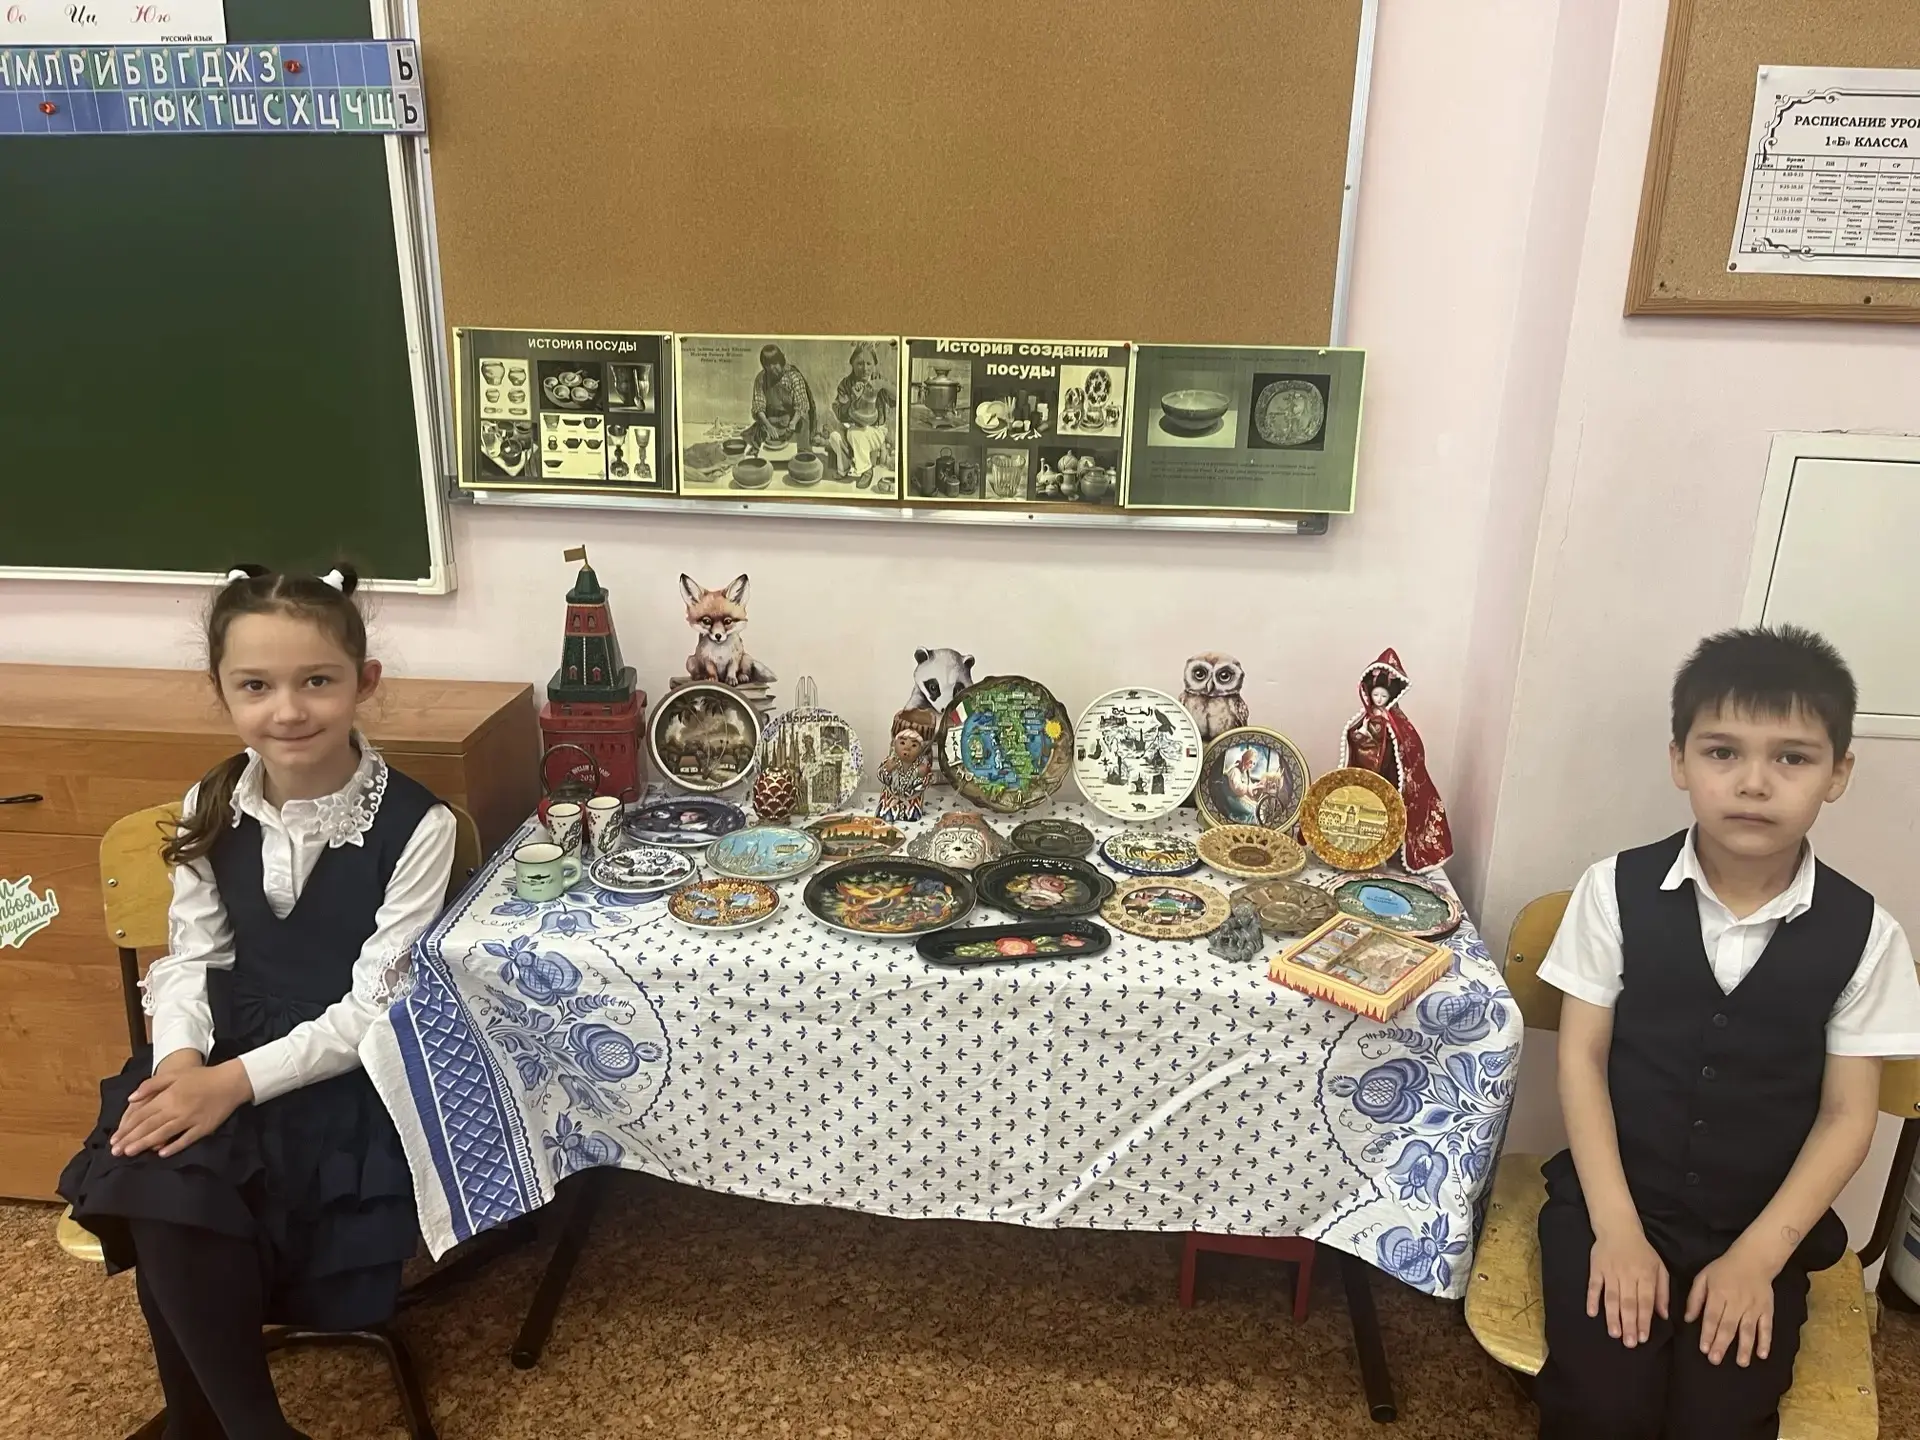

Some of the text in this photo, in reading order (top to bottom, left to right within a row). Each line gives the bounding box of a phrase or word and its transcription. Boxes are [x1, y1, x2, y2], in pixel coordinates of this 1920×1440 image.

[160, 34, 192, 42] РУССКИЙ
[1794, 115, 1886, 128] РАСПИСАНИЕ
[1854, 137, 1909, 149] КЛАССА
[528, 338, 637, 353] ИСТОРИЯ ПОСУДЫ
[936, 339, 1109, 359] История создания
[986, 363, 1056, 378] посуды
